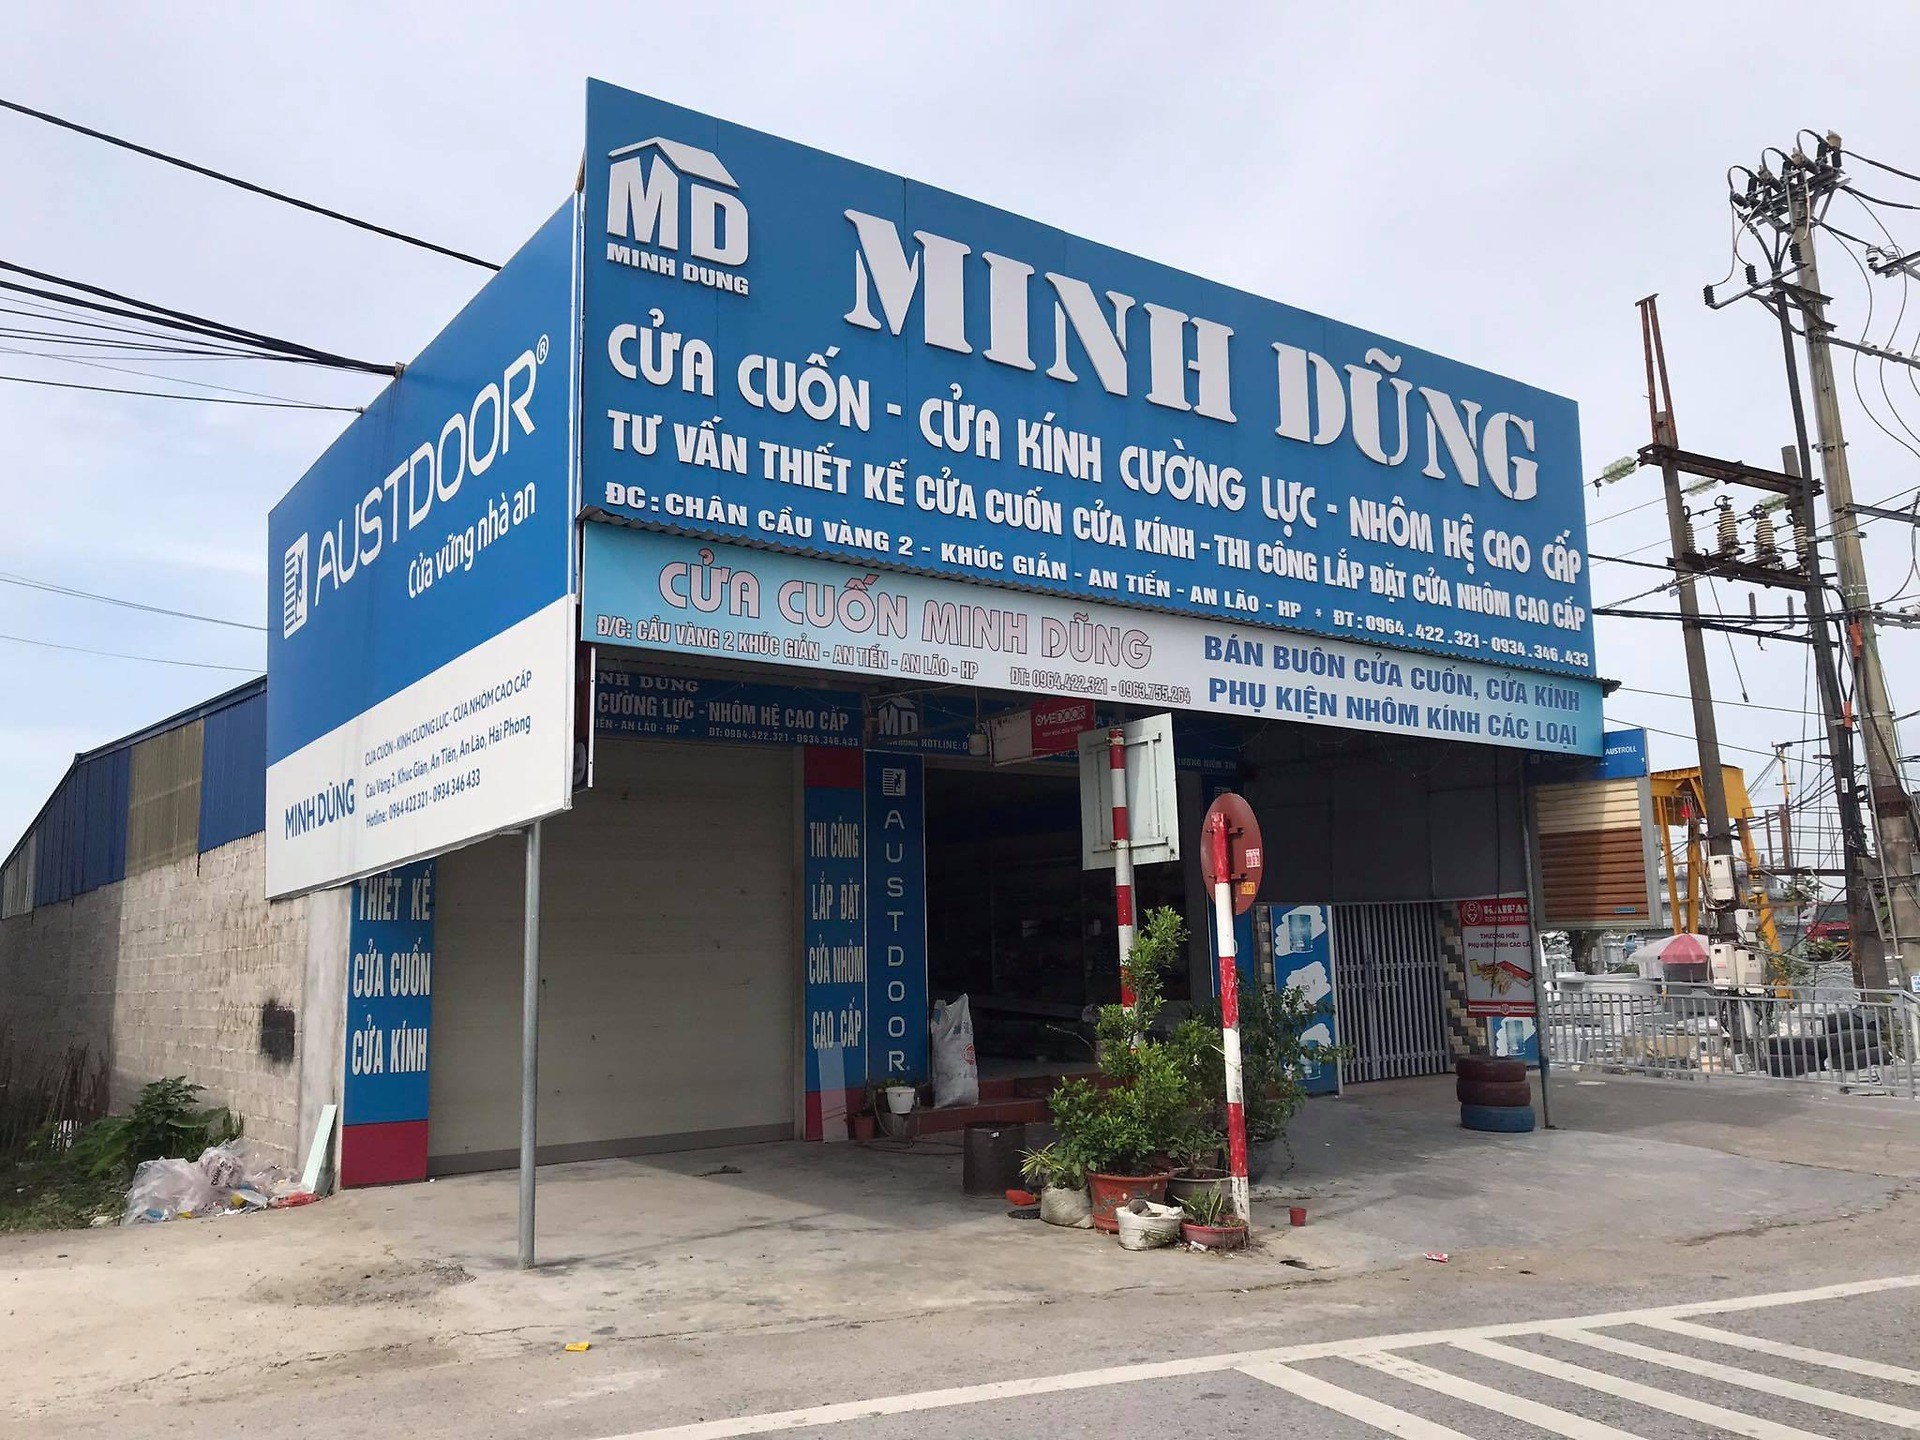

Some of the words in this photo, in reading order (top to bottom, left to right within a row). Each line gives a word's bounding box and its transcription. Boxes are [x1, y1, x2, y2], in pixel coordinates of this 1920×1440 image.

[606, 154, 749, 266] MD
[606, 242, 676, 277] MINH
[682, 264, 749, 296] DUNG
[844, 208, 1238, 423] MINH
[1271, 346, 1538, 501] DŨNG
[607, 307, 714, 397] CỬA
[737, 345, 871, 432] CUỐN
[919, 383, 1000, 460] CỬA
[1017, 411, 1102, 483] KÍNH
[1119, 438, 1246, 511] CƯỜNG
[1261, 475, 1316, 537] LỰC
[1349, 496, 1434, 554] NHÔM
[1443, 513, 1475, 576] HỆ
[1482, 529, 1531, 573] CAO
[1541, 528, 1582, 585] CẤP
[408, 551, 433, 599] Cửa
[435, 525, 475, 580] vững
[477, 492, 509, 552] nhà
[512, 481, 536, 526] an
[606, 409, 662, 455] TƯ
[674, 415, 747, 475] VẤN
[759, 442, 851, 496] THIẾT
[863, 457, 908, 506] KẾ
[916, 466, 978, 520] CỬA
[985, 486, 1062, 535] CUỐN
[1073, 499, 1127, 548] CỬA
[1135, 515, 1195, 560] KÍNH
[1214, 534, 1251, 570] THI
[1257, 540, 1317, 582] CÔNG
[1324, 548, 1364, 590] LẮP
[1370, 562, 1406, 602] ĐẶT
[1413, 566, 1451, 607] CỬA
[1456, 581, 1511, 617] NHÔM
[1515, 599, 1550, 626] CAO
[1552, 597, 1586, 632] CẤP
[665, 494, 748, 527] CHÂN
[758, 506, 812, 538] CẦU
[823, 519, 890, 553] VÀNG
[898, 535, 913, 556] 2
[941, 543, 1004, 571] KHÚC
[1013, 552, 1067, 581] GIẢN
[1088, 567, 1118, 590] AN
[1125, 569, 1171, 599] TIẾN
[1190, 585, 1218, 605] AN
[1224, 589, 1259, 613] LÃO
[1278, 599, 1302, 619] HP
[658, 547, 761, 619] CỬA
[777, 574, 908, 639] CUỐN
[922, 599, 1028, 656] MINH
[1041, 612, 1152, 669] DŨNG
[596, 614, 632, 639] Đ/C:
[636, 614, 671, 643] CẦU
[674, 619, 720, 650] VÀNG
[723, 630, 735, 651] 2
[738, 629, 780, 657] KHÚC
[832, 644, 855, 667] AN
[857, 643, 889, 670] TIẾN
[900, 652, 921, 674] AN
[923, 652, 949, 677] LÃO
[960, 658, 979, 679] HP
[1010, 666, 1031, 686] ĐT:
[1031, 668, 1108, 696] 0964.422.321
[1118, 681, 1192, 705] 0963.755.264
[1203, 633, 1264, 667] BÁN
[1272, 643, 1346, 680] BUÔN
[1354, 653, 1403, 688] CỬA
[1410, 663, 1480, 701] CUỐN,
[1486, 671, 1529, 704] CỬA
[1534, 682, 1581, 712] KÍNH
[495, 680, 513, 703] CAO
[597, 690, 657, 716] CƯỜNG
[662, 697, 694, 722] LỰC
[709, 699, 756, 725] NHÔM
[761, 703, 780, 730] HỆ
[786, 708, 814, 729] CAO
[820, 705, 849, 731] CẤP
[1209, 677, 1267, 715] PHỤ
[1276, 685, 1337, 721] KIỆN
[1346, 693, 1420, 730] NHÔM
[1426, 702, 1481, 736] KÍNH
[1487, 709, 1529, 741] CÁC
[1535, 720, 1578, 749] LOẠI
[430, 753, 440, 771] An
[459, 740, 470, 758] An
[621, 720, 635, 731] AN
[666, 724, 679, 734] HP
[1605, 745, 1637, 756] AUSTROLL
[285, 796, 315, 840] MINH
[389, 800, 404, 820] 0964
[405, 795, 417, 815] 422
[417, 790, 429, 810] 321
[432, 781, 450, 803] 0934
[451, 774, 465, 796] 346
[466, 768, 481, 790] 433
[810, 821, 827, 857] THI
[830, 815, 859, 858] CÔNG
[411, 864, 433, 921] KẾ
[812, 871, 833, 921] LẮP
[840, 877, 860, 924] ĐẶT
[353, 938, 384, 998] CỬA
[390, 937, 431, 997] CUỐN
[809, 933, 831, 985] CỬA
[833, 942, 864, 984] NHÔM
[352, 1014, 383, 1075] CỬA
[390, 1020, 428, 1073] KÍNH
[812, 1011, 834, 1050] CAO
[840, 997, 862, 1048] CẤP
